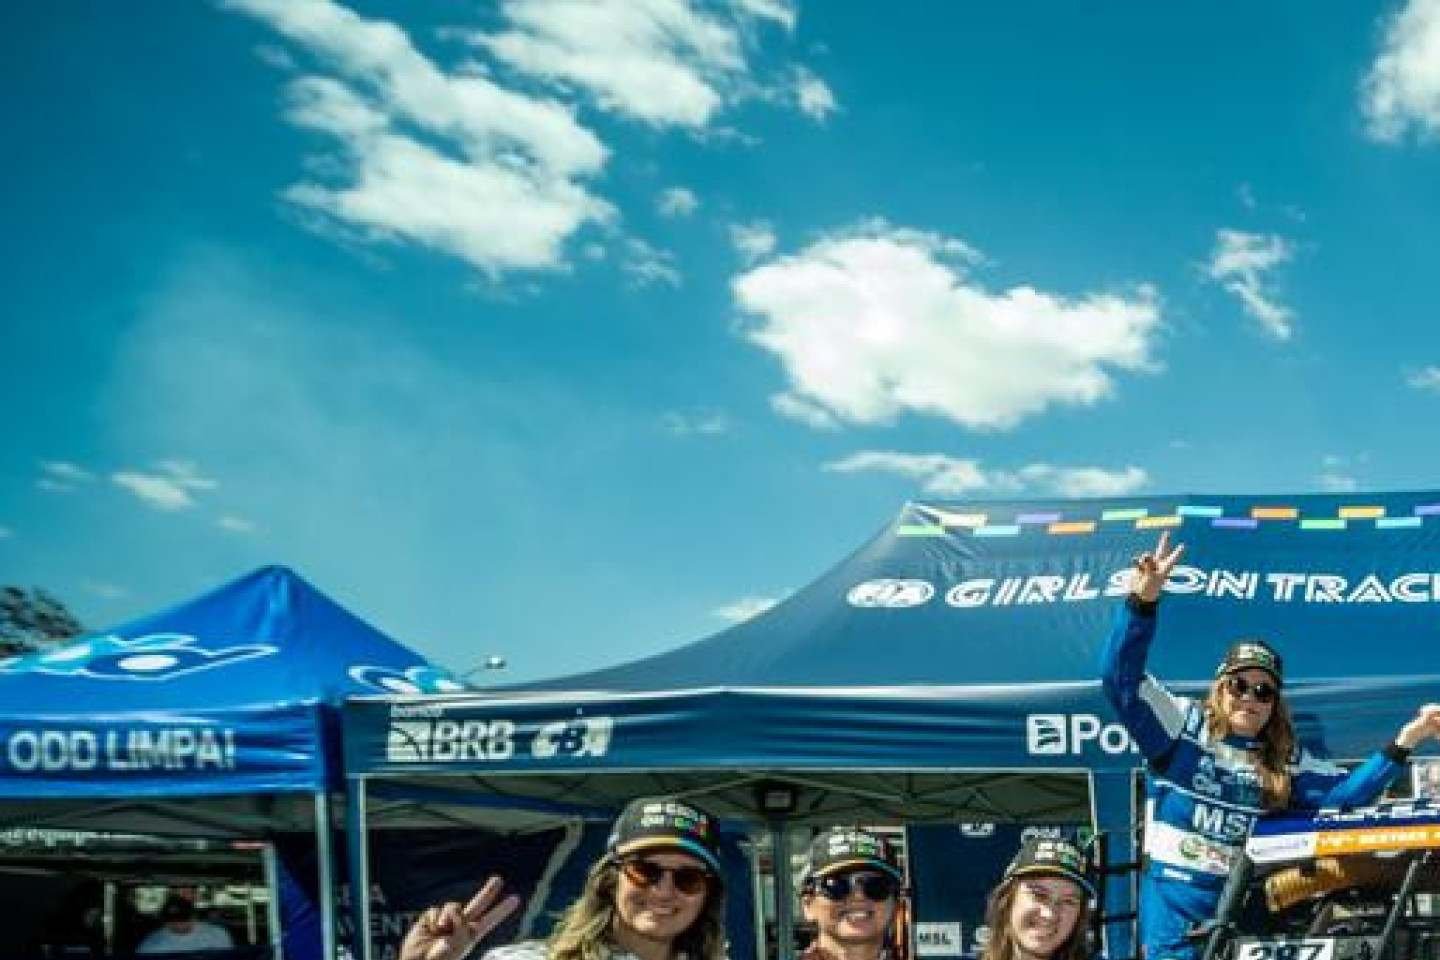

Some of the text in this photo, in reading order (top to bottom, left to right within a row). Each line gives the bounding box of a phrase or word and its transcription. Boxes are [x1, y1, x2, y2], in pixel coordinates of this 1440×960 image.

[8, 728, 235, 771] ODD LIMPA!
[433, 719, 515, 760] BRB
